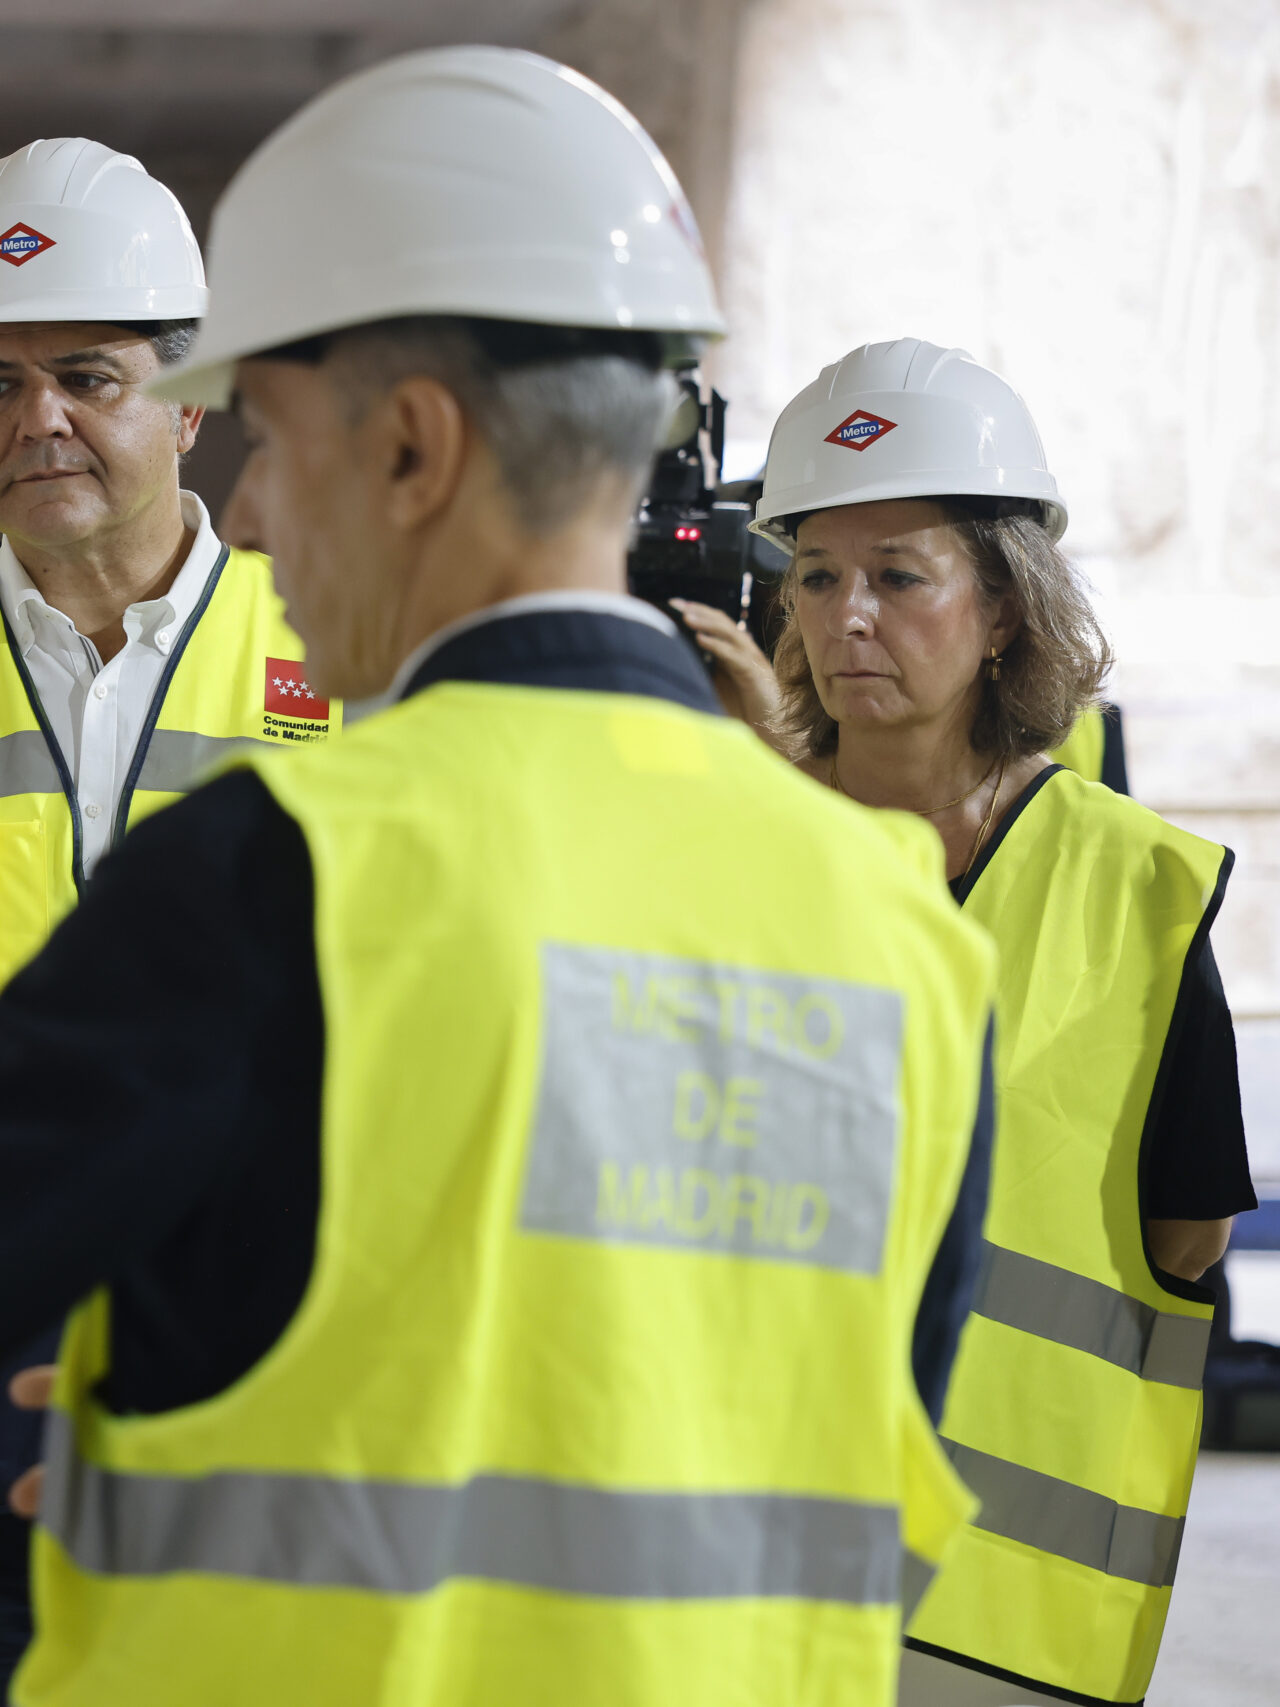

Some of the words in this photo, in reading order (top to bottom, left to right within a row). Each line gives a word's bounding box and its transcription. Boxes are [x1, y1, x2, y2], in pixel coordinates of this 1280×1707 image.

[3, 240, 36, 251] Metro
[843, 425, 877, 439] Metro
[263, 716, 329, 732] Comunidad
[263, 727, 278, 737] de
[612, 968, 845, 1062] METRO
[672, 1068, 767, 1149] DE
[596, 1157, 831, 1251] MADRID
